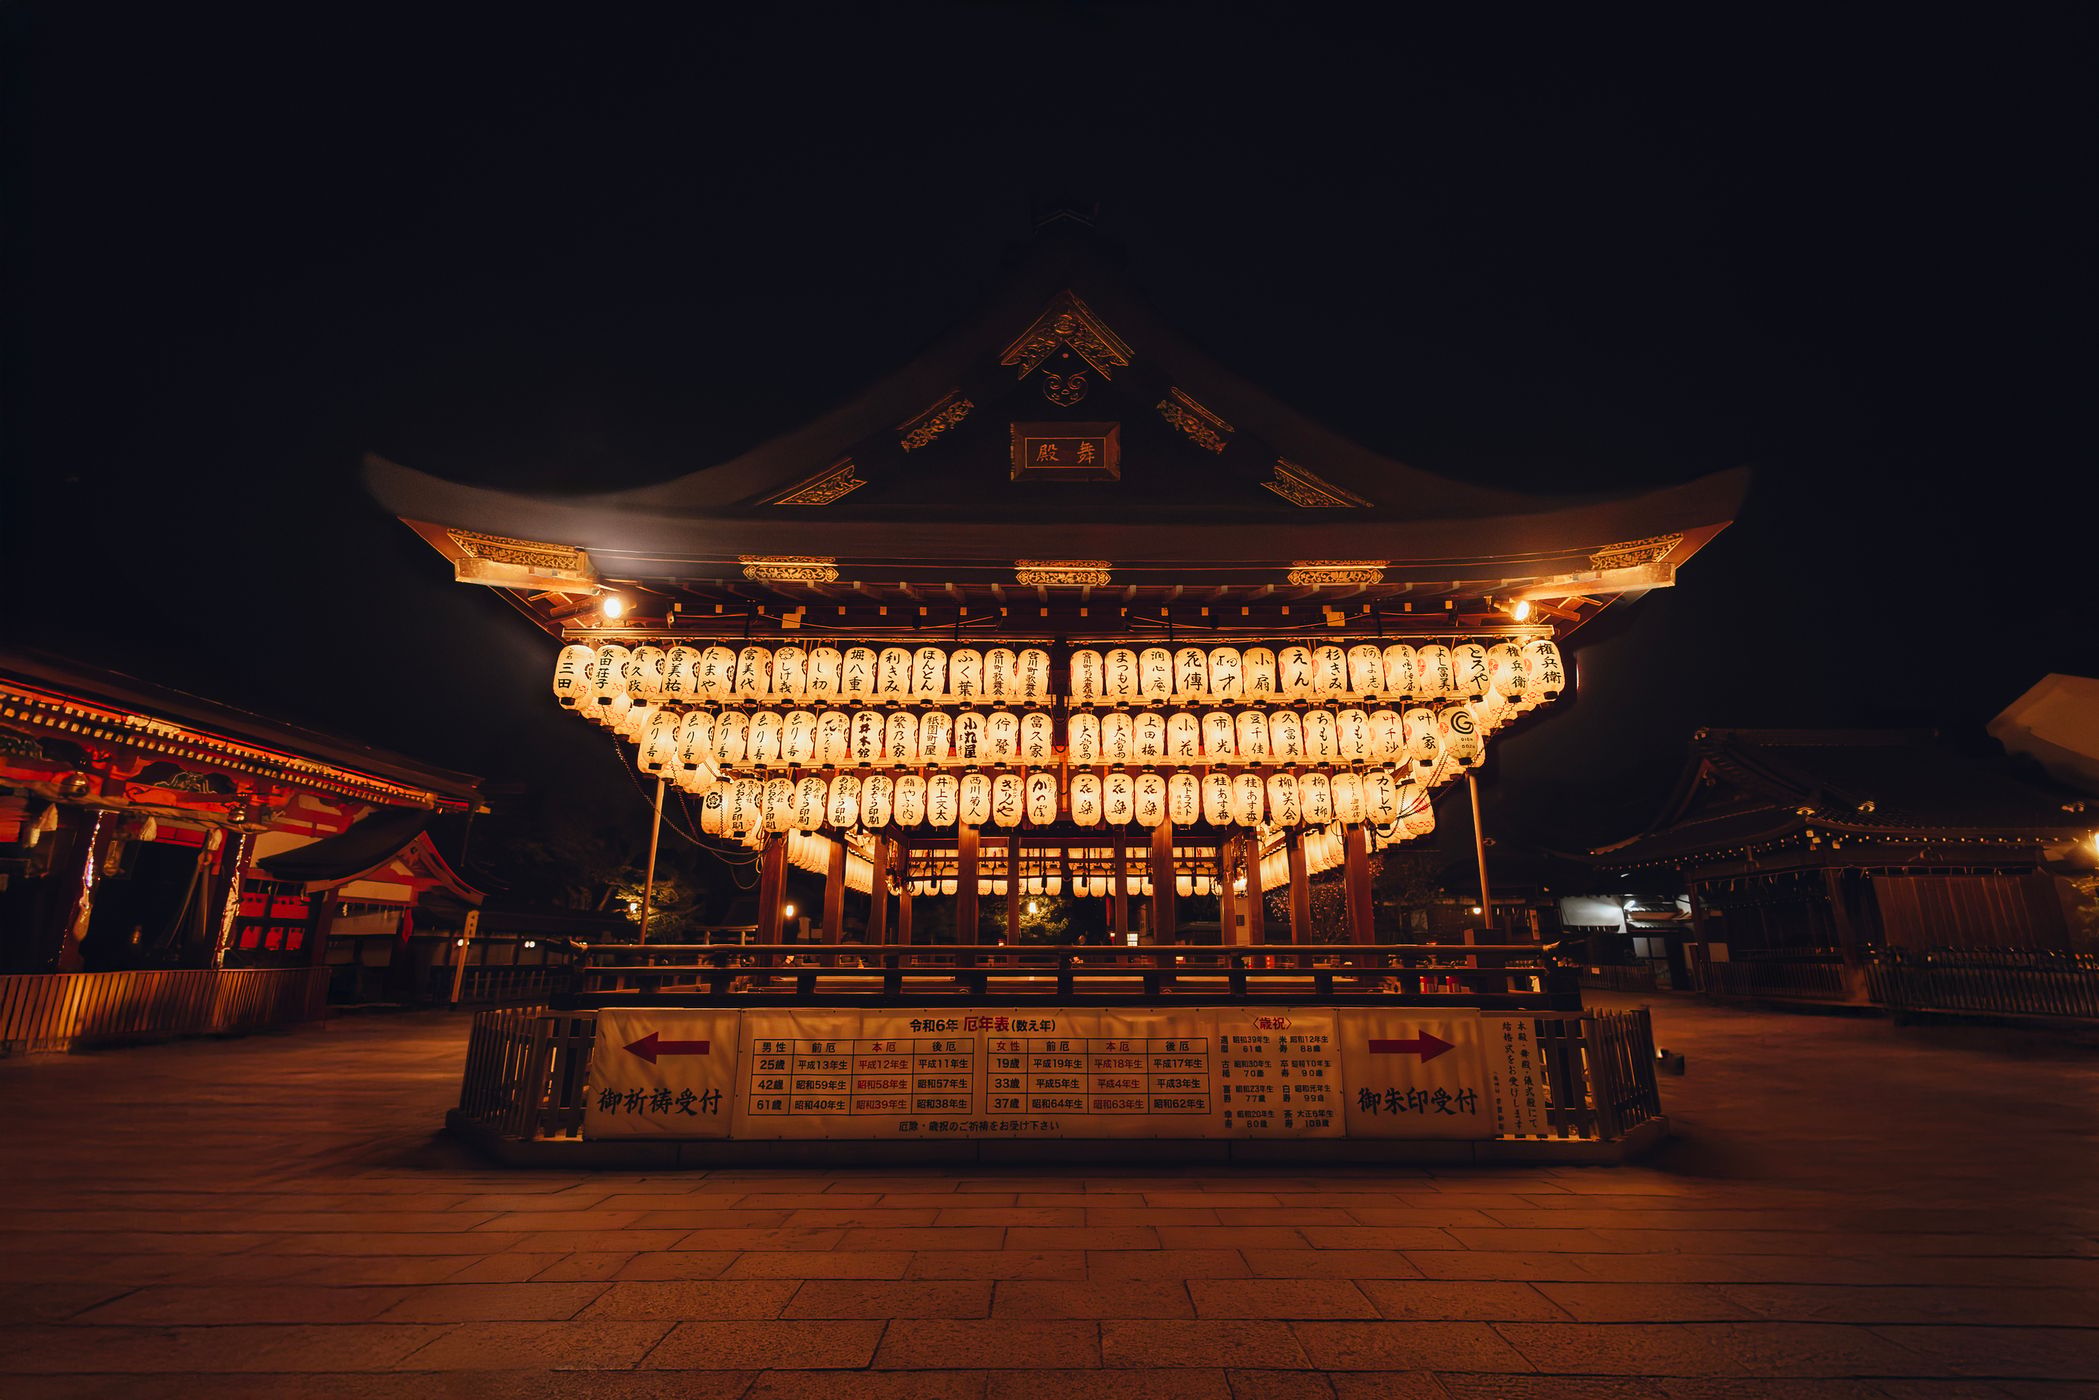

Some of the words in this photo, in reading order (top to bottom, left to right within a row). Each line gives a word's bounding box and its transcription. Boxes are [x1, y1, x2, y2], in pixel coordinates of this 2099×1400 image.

[557, 662, 575, 689] 三田
[701, 648, 720, 692] たまや
[740, 648, 758, 691] 富美代
[812, 649, 830, 690] いし初
[848, 649, 865, 692] 堀八重
[884, 651, 901, 692] 利きみ
[957, 651, 975, 697] ふく葉
[1116, 651, 1134, 695] まつもと
[1183, 650, 1203, 692] 花傳
[1255, 652, 1272, 692] 小扇
[1292, 649, 1310, 687] えん
[1325, 648, 1343, 690] 杉きみ
[1536, 642, 1561, 685] 権兵衛
[857, 713, 873, 759] 松井本館
[1029, 715, 1044, 759] 富久家
[1178, 717, 1194, 757] 小花
[1212, 716, 1231, 754] 市光
[1249, 713, 1265, 755] 豆千佳
[1281, 712, 1299, 756] 久富美
[1316, 712, 1329, 756] ちもと
[1351, 711, 1364, 755] ちもと
[1418, 711, 1436, 750] 叶家
[935, 776, 949, 821] 井上文太
[1213, 776, 1230, 820] 桂あす香
[1244, 777, 1260, 822] 桂あす香
[1376, 775, 1393, 816] カトレヤ
[910, 1019, 959, 1033] 令和6年
[964, 1016, 1009, 1033] 厄年表
[759, 1059, 785, 1070] 25歳
[798, 1059, 848, 1070] 平成13年生
[858, 1058, 908, 1070] 平成12年生
[919, 1058, 968, 1069] 平成11年生
[761, 1041, 786, 1053] 男性
[811, 1042, 836, 1054] 前厄
[872, 1041, 896, 1053] 本厄
[932, 1041, 956, 1053] 後厄
[996, 1041, 1020, 1052] 女性
[1046, 1040, 1070, 1052] 前厄
[1106, 1041, 1130, 1052] 本厄
[1166, 1041, 1190, 1052] 後厄
[996, 1058, 1020, 1069] 19歳
[1033, 1058, 1082, 1069] 平成19年生
[1094, 1058, 1142, 1069] 平成18年生
[1153, 1058, 1203, 1069] 平成17年生
[598, 1087, 724, 1116] 御祈祷受付
[758, 1079, 783, 1091] 42歳
[796, 1079, 846, 1090] 昭和59年生
[857, 1079, 907, 1090] 昭和58年生
[917, 1078, 968, 1089] 昭和57年生
[994, 1078, 1020, 1089] 33歳
[1036, 1078, 1079, 1089] 平成5年生
[1097, 1078, 1140, 1089] 平成4年生
[1157, 1078, 1200, 1089] 平成3年生
[994, 1098, 1020, 1109] 37歳
[1032, 1098, 1082, 1109] 昭和64年生
[1093, 1098, 1144, 1109] 昭和63年生
[1154, 1098, 1204, 1109] 昭和62年生
[1356, 1087, 1479, 1115] 御朱印受付
[757, 1100, 782, 1111] 61歳
[795, 1100, 845, 1110] 昭和40年生
[856, 1099, 907, 1110] 昭和39年生
[917, 1098, 967, 1109] 昭和38年生
